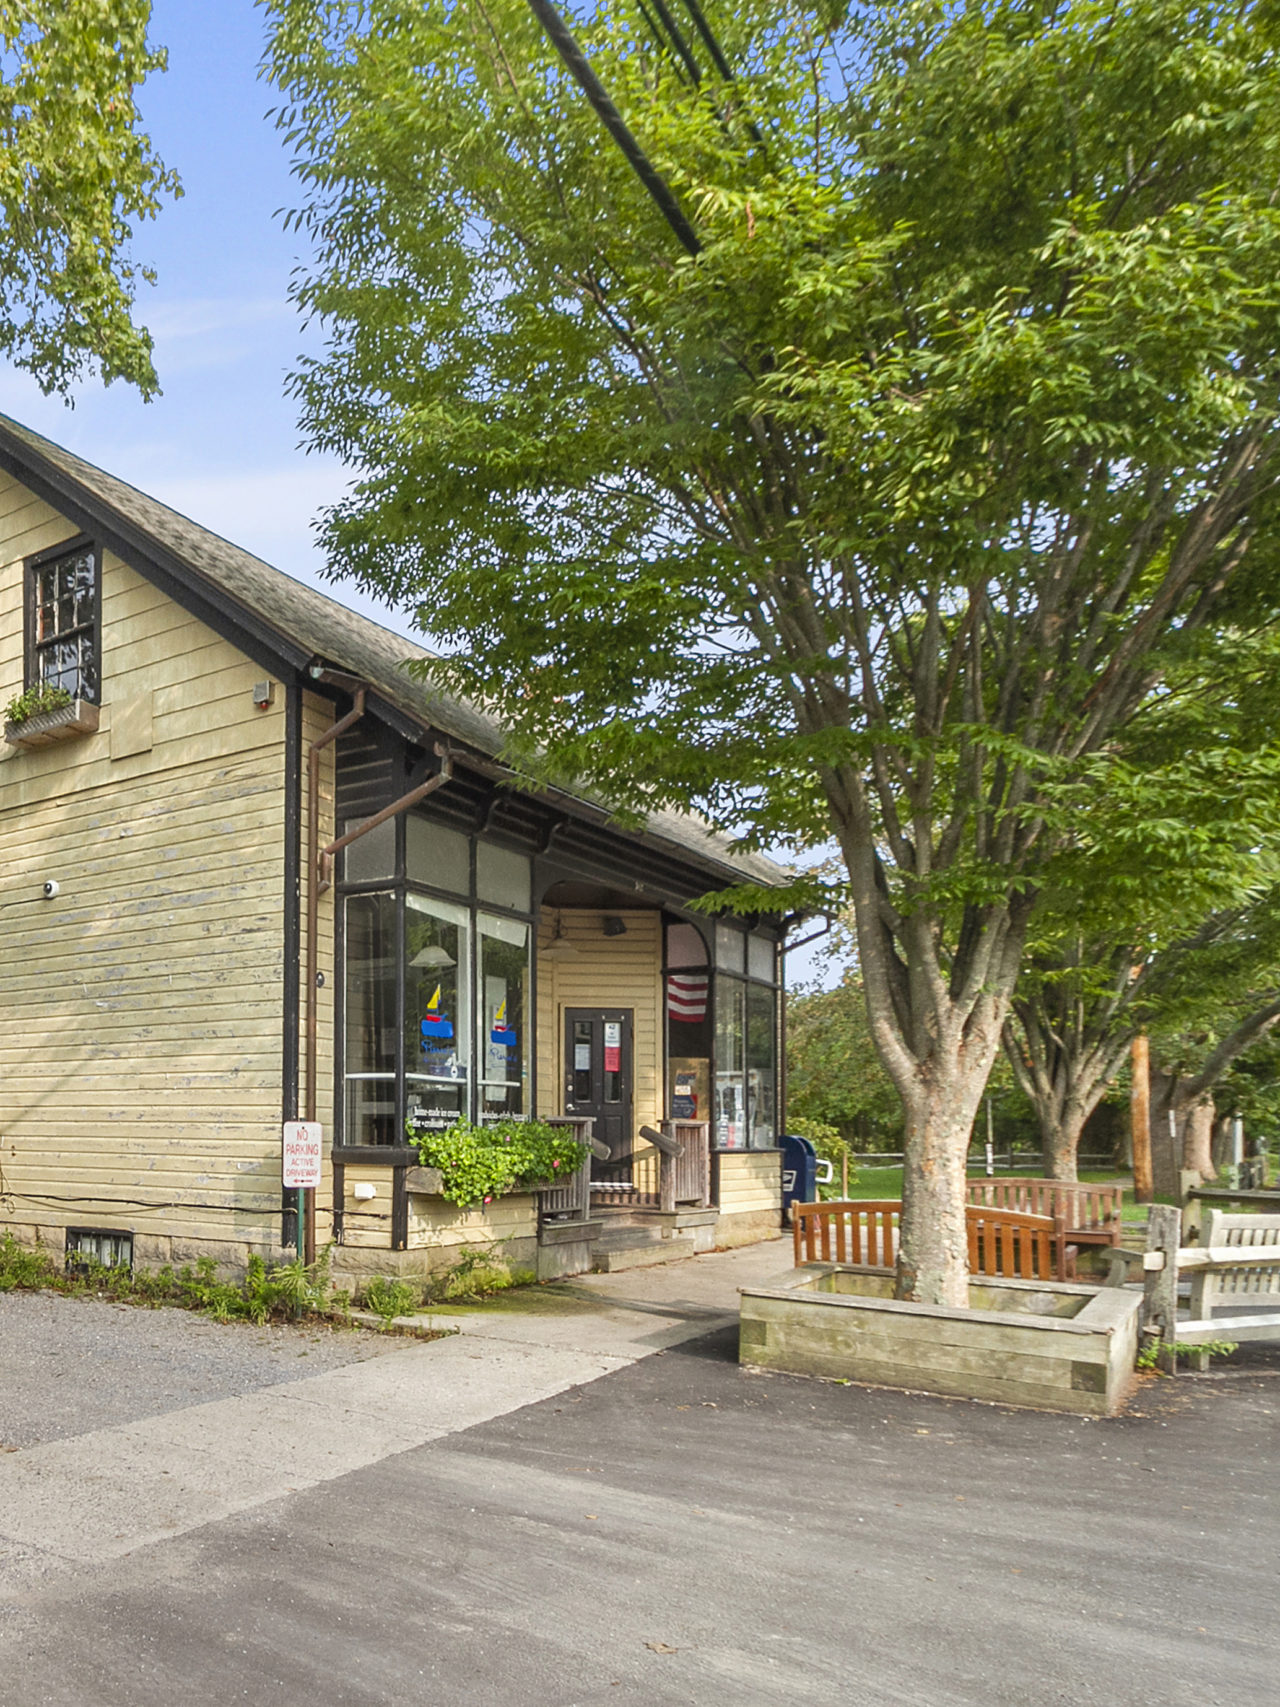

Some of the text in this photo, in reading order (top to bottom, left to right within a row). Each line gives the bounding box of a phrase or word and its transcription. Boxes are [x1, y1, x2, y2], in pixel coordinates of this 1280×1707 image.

[297, 1129, 308, 1141] NO
[286, 1143, 318, 1156] PARKING
[291, 1158, 314, 1167] ACTIVE
[286, 1168, 318, 1177] DRIVEWAY
